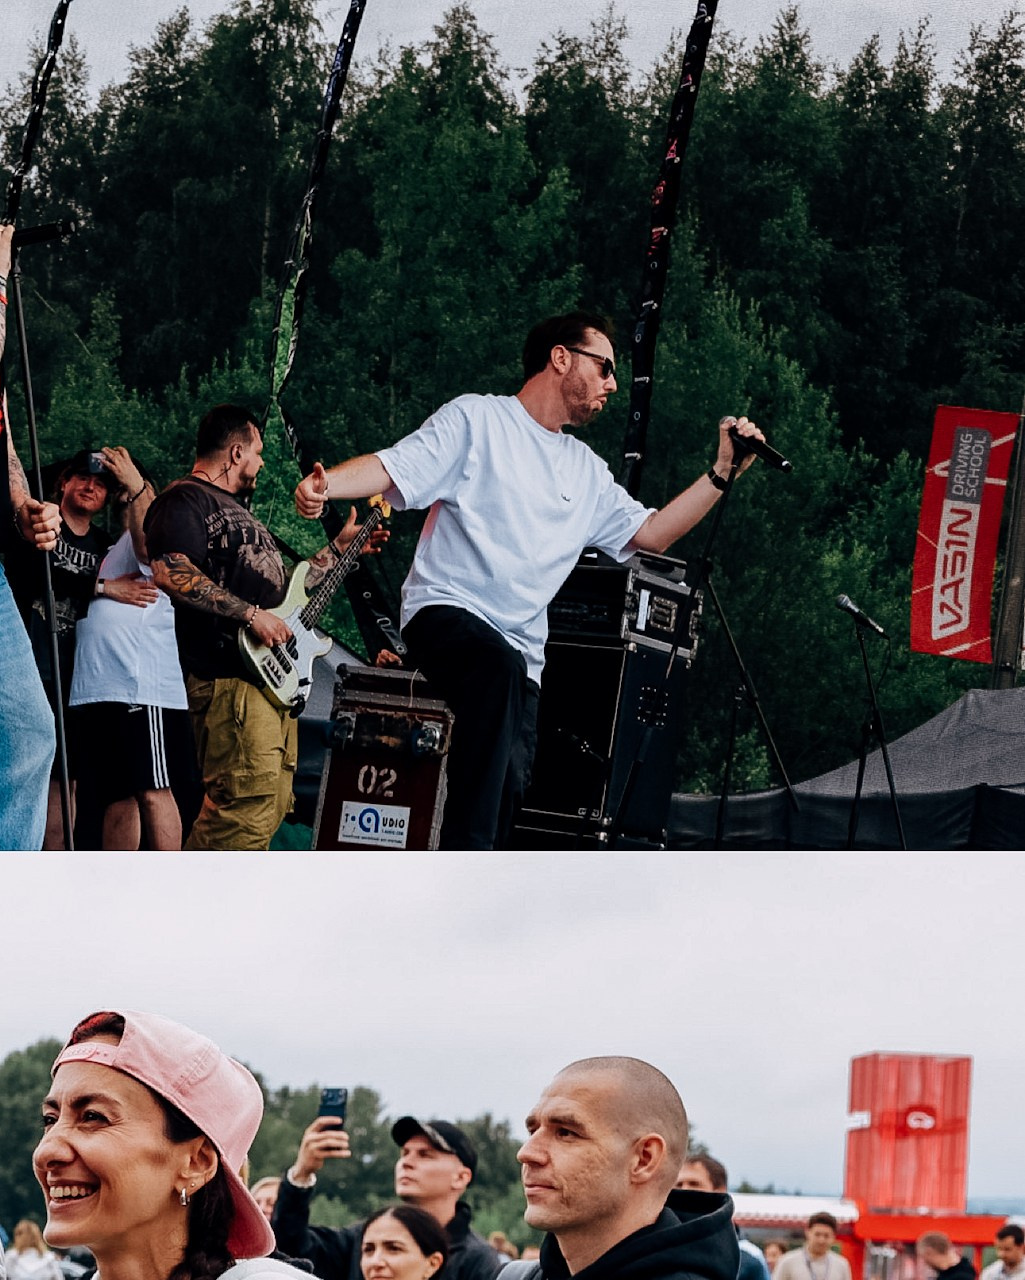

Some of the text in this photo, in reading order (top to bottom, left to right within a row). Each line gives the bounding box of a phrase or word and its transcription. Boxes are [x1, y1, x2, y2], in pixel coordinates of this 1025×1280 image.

[952, 432, 973, 496] DRIVING
[965, 435, 987, 498] SCHOOL
[939, 508, 973, 630] VASIN
[357, 765, 397, 797] 02
